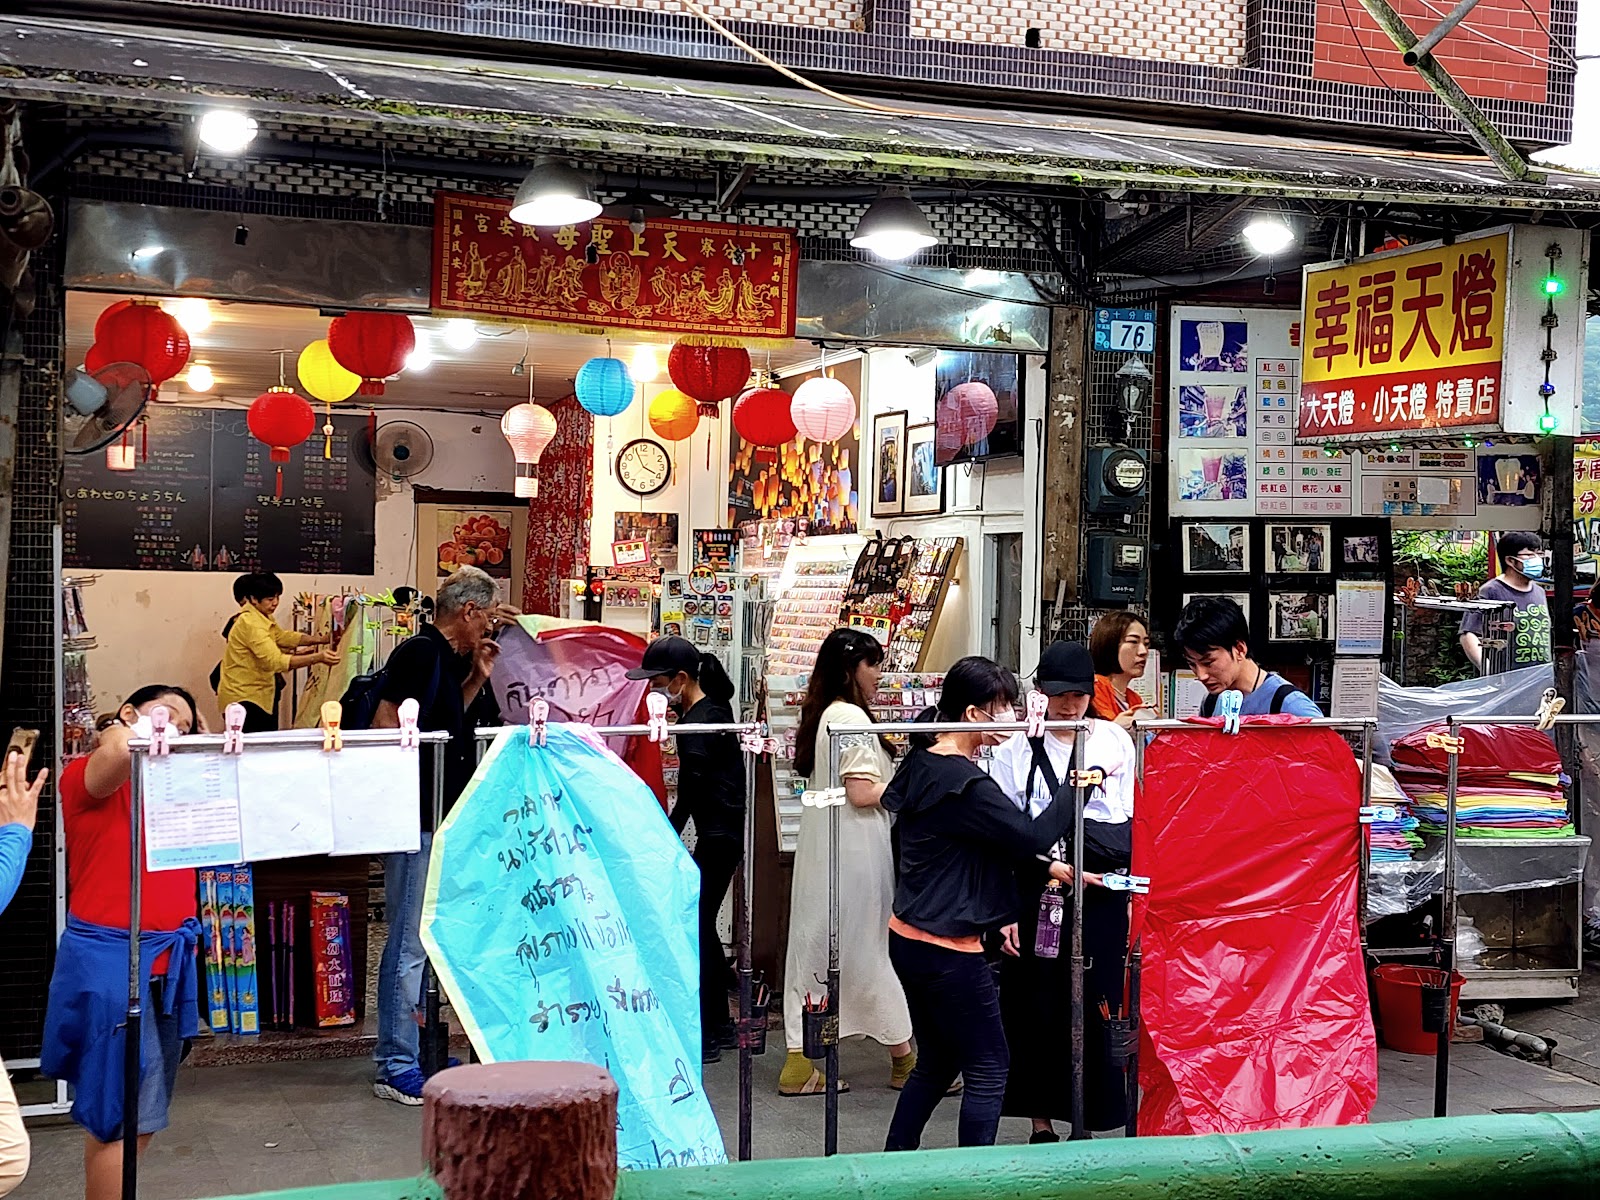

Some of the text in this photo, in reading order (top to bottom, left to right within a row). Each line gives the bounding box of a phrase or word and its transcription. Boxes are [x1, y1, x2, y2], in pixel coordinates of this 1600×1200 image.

[1112, 310, 1152, 321] 十分街
[1312, 248, 1497, 373] 幸福天燈
[1120, 324, 1146, 349] 76
[1435, 376, 1496, 419] 特賣店
[66, 487, 187, 502] しあわせのちょうちん
[1260, 484, 1287, 493] 桃紅色
